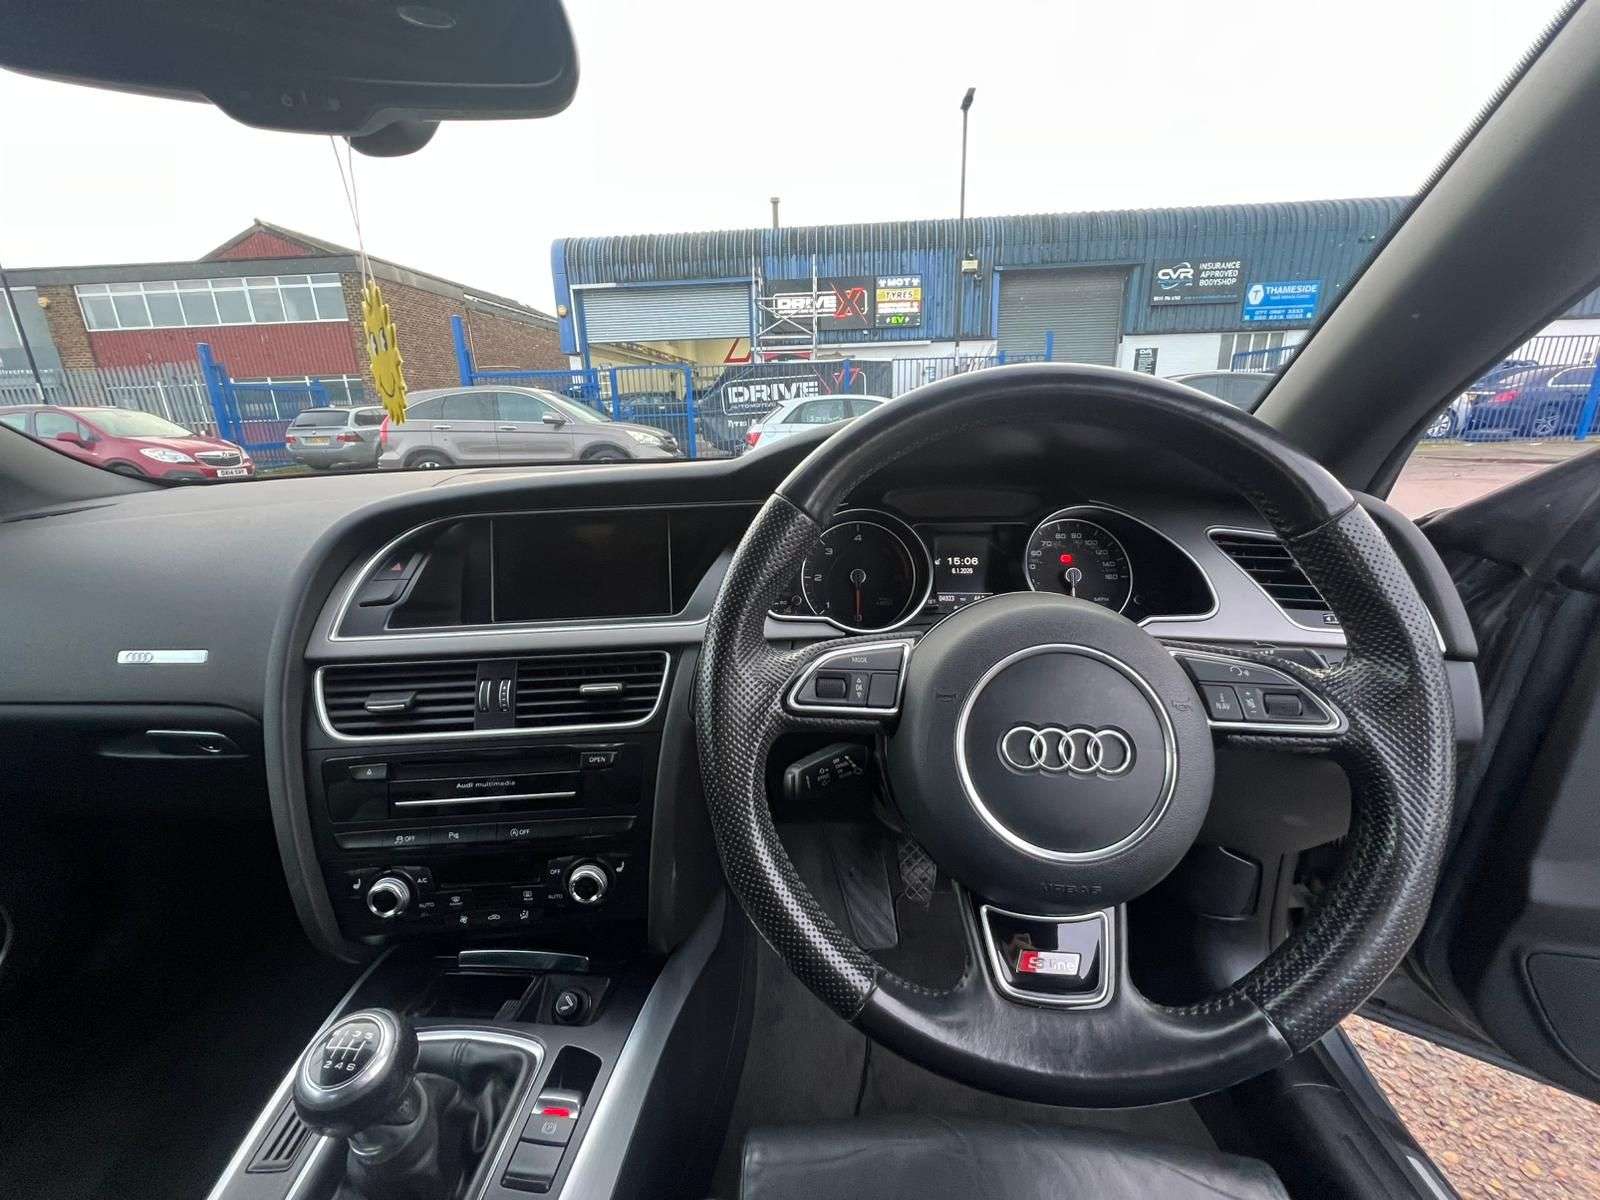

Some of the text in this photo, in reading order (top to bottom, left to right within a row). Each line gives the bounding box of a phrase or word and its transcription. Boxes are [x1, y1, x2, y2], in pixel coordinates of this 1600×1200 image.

[1200, 261, 1240, 270] INSURANCE
[1158, 268, 1194, 280] CVR
[1200, 270, 1239, 278] APPROVED
[1199, 278, 1237, 287] BODYSHOP
[1266, 285, 1318, 294] THAMESIDE
[886, 291, 913, 299] TYRES
[728, 381, 819, 404] DRIVE
[946, 556, 979, 565] 15:06
[1215, 702, 1230, 710] NAV
[475, 780, 517, 788] multimedia
[323, 1060, 356, 1071] 2 4 6
